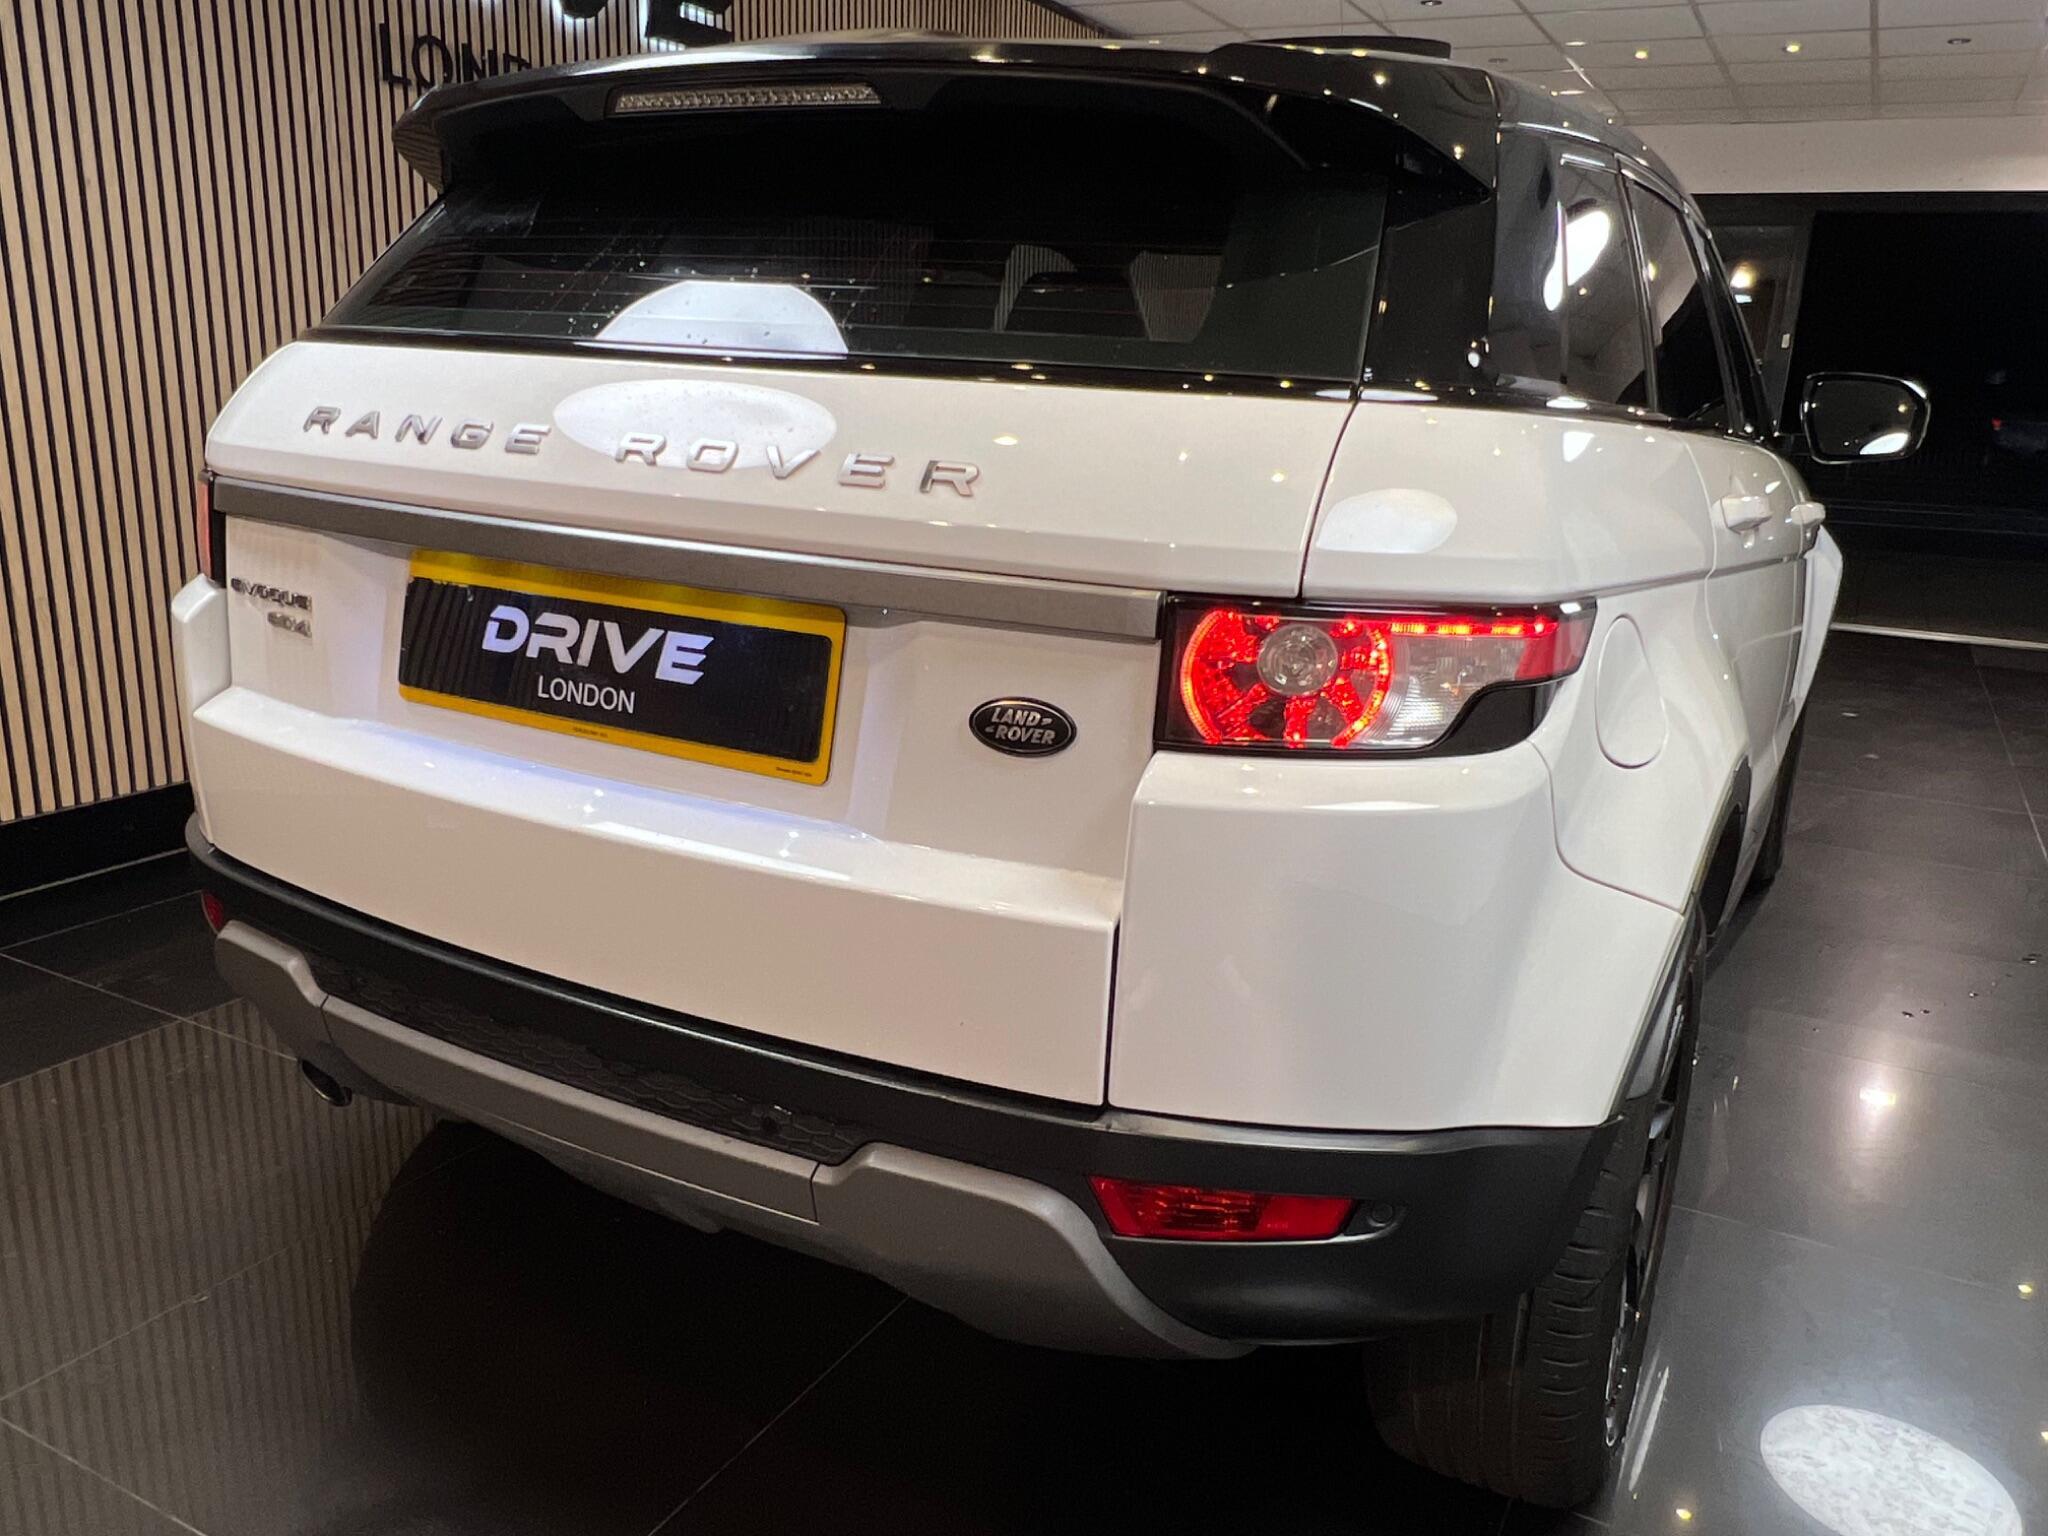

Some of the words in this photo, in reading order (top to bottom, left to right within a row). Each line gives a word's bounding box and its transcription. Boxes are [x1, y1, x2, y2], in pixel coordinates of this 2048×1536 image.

[303, 405, 551, 455] RANGE
[615, 433, 980, 496] ROVER
[481, 604, 714, 685] DRIVE
[537, 675, 635, 714] LONDON
